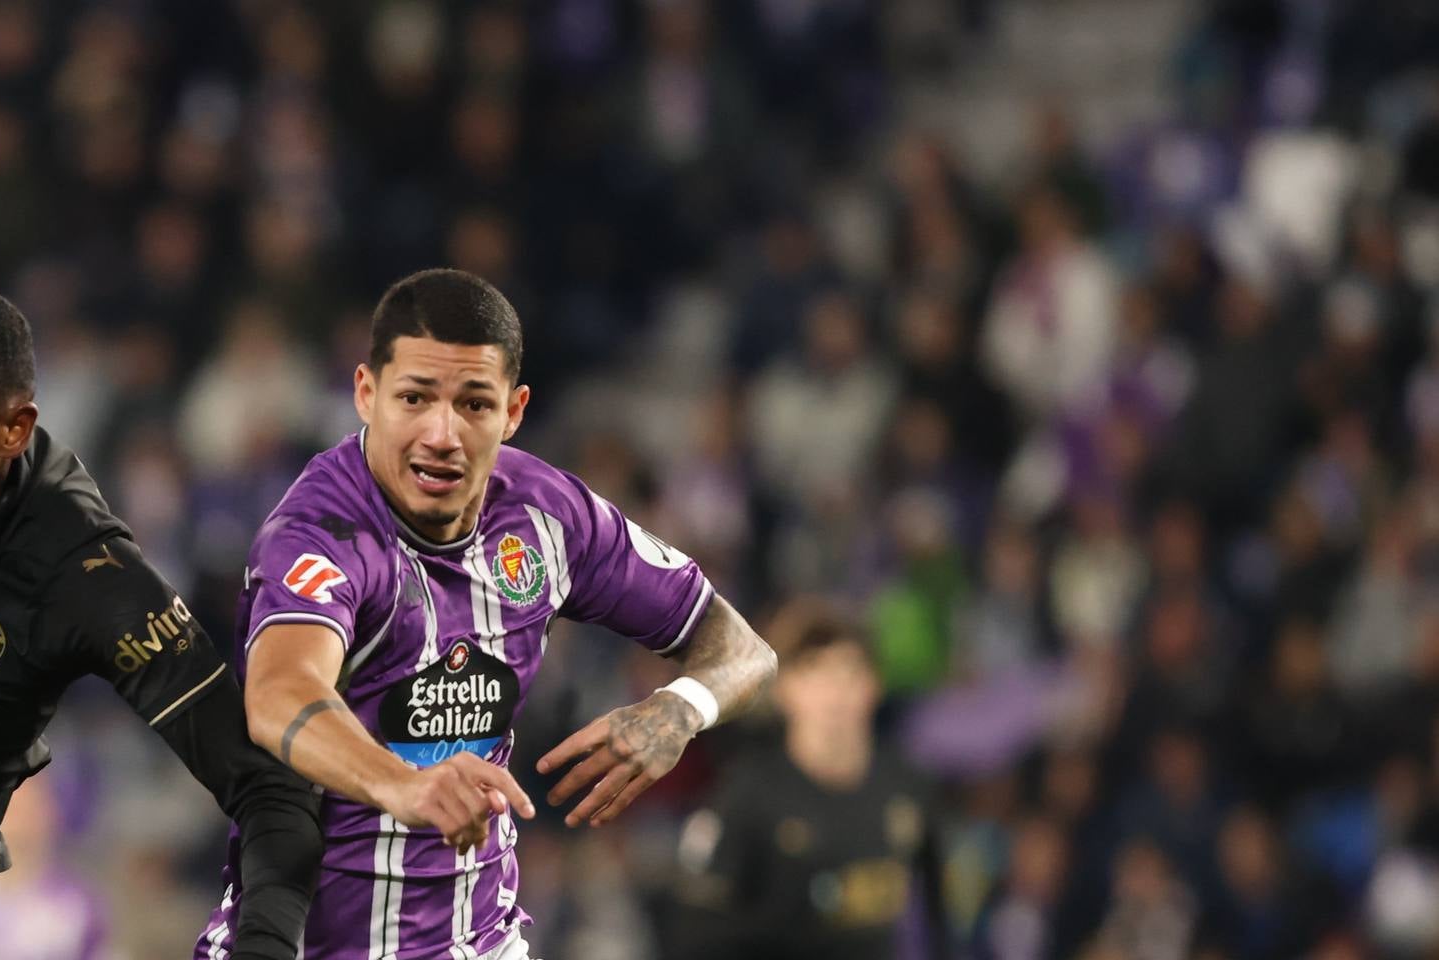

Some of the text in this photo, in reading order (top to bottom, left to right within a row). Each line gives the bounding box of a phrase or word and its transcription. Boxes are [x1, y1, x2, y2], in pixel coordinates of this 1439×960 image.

[115, 595, 191, 672] divina
[408, 674, 502, 707] Estrella
[408, 705, 493, 737] Galicia
